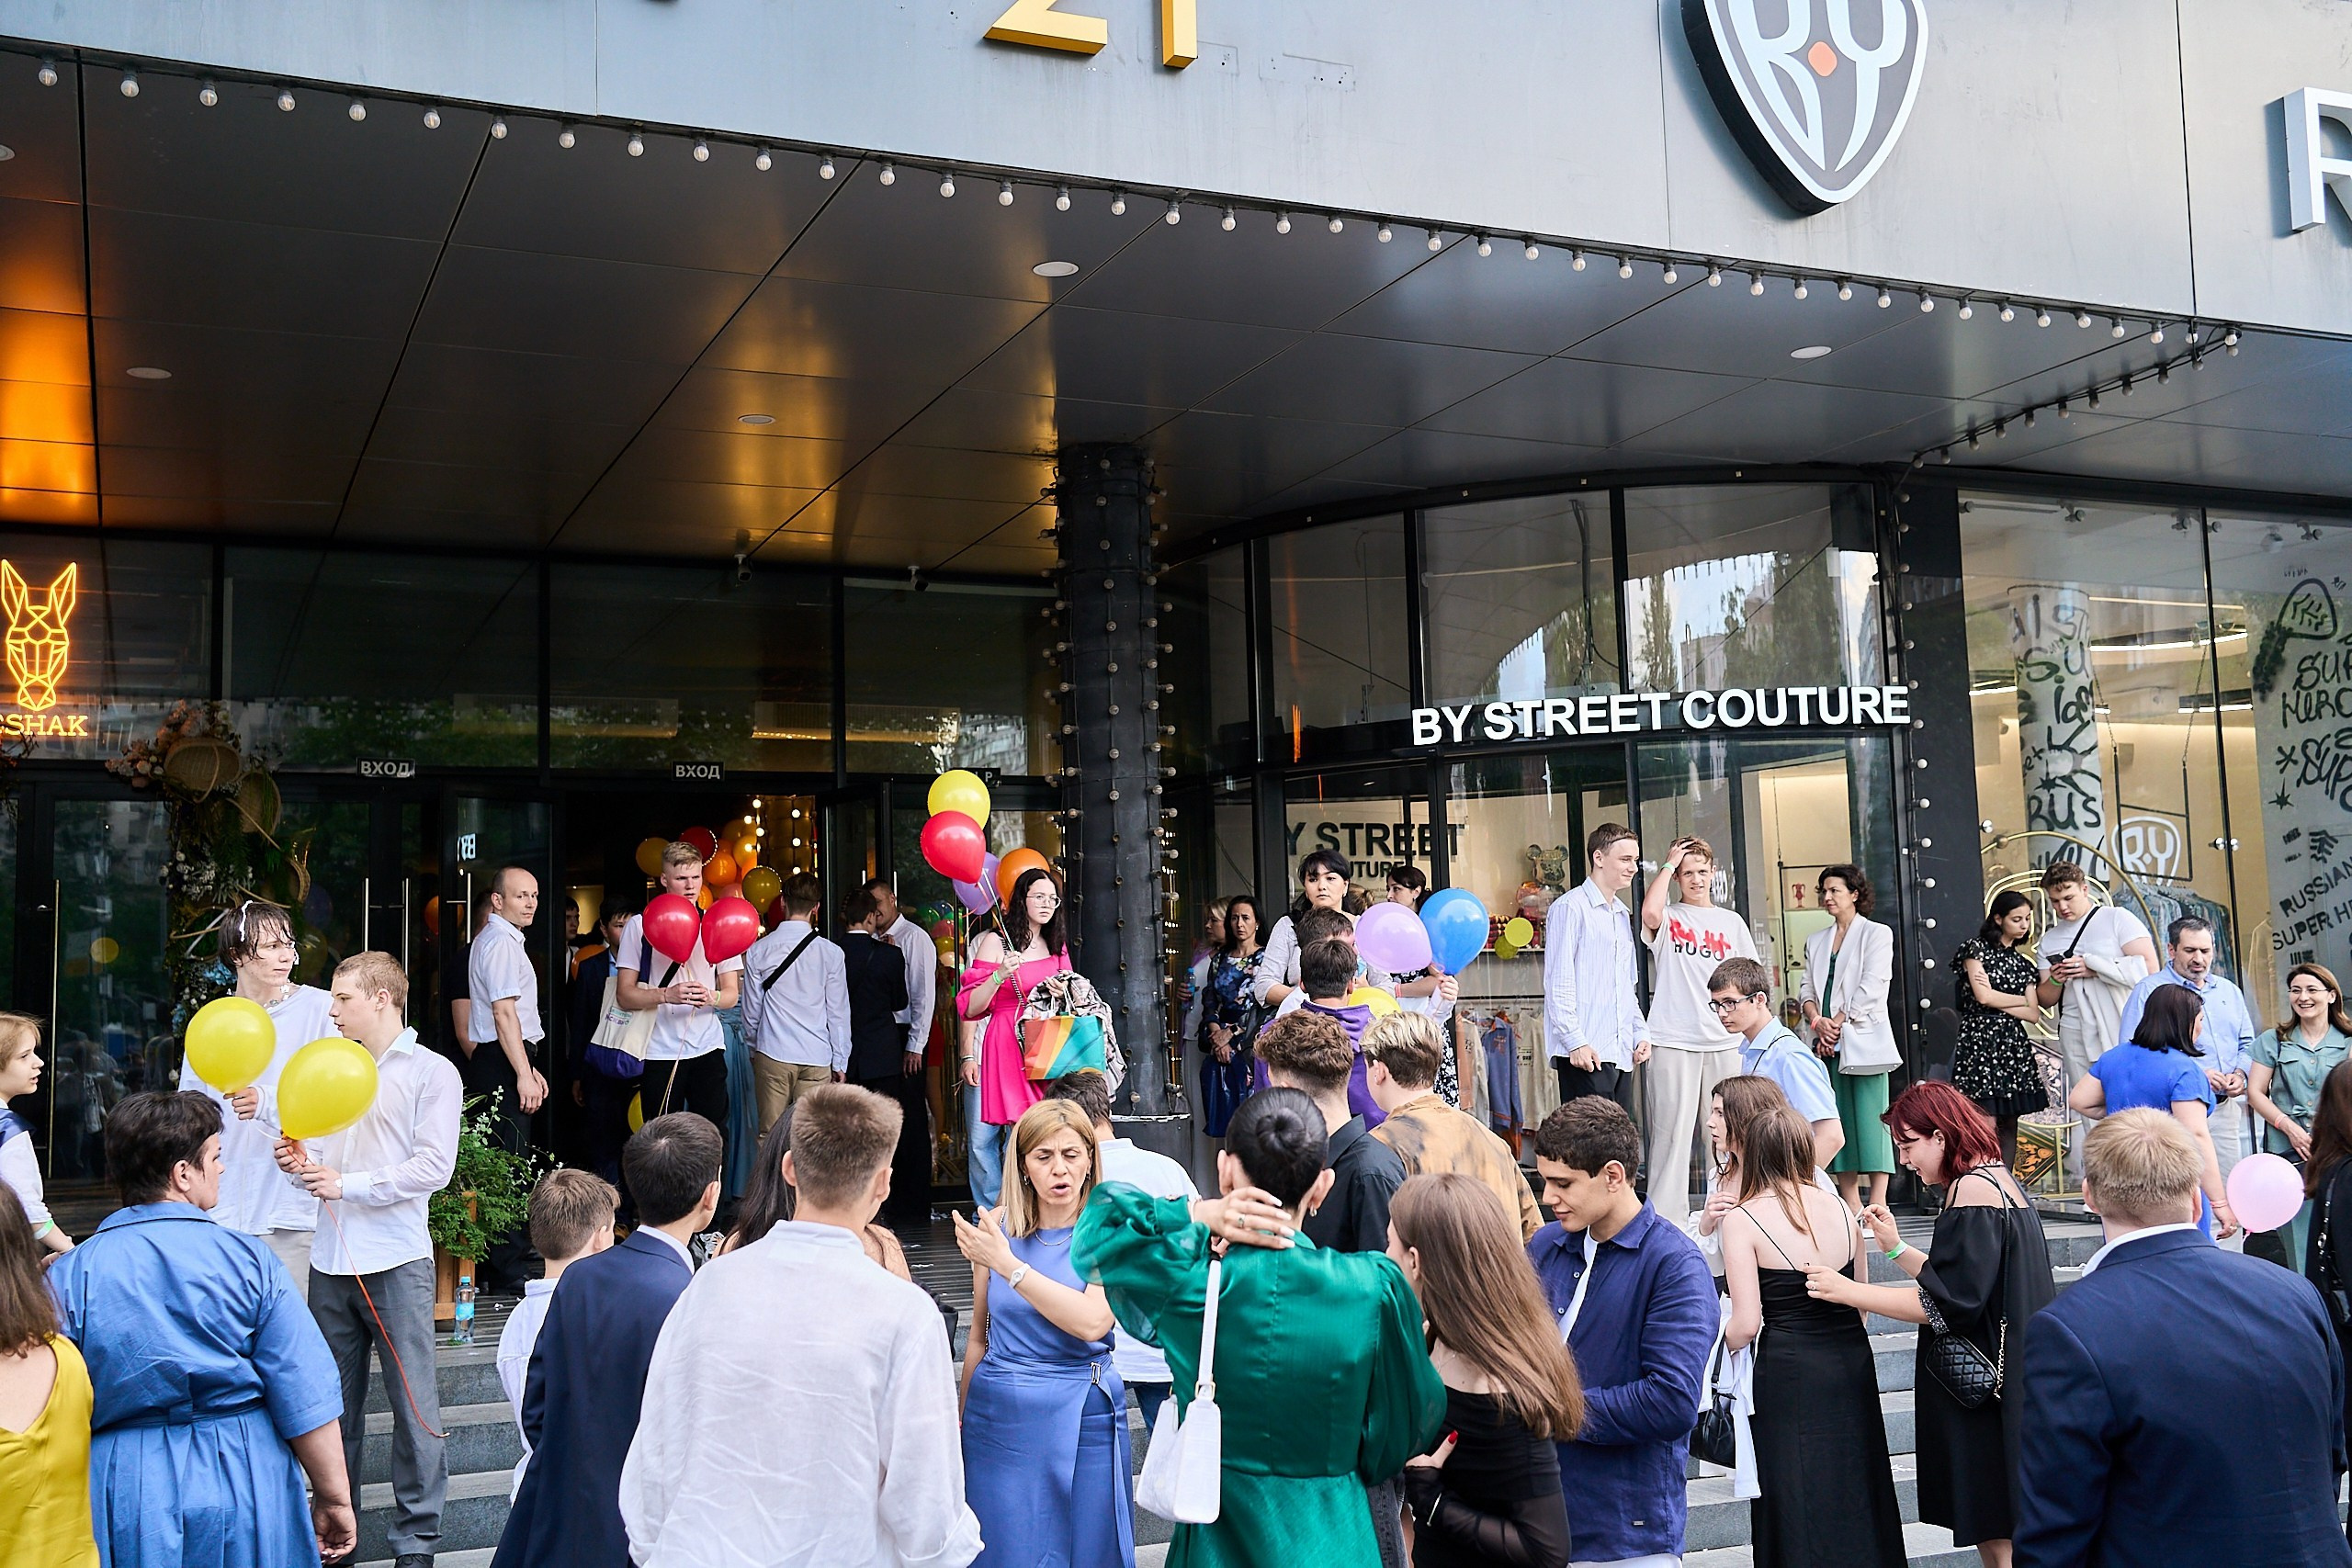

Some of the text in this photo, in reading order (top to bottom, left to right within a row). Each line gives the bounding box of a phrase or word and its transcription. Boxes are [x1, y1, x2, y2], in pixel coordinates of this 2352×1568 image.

[1411, 685, 1912, 746] BY STREET COUTURE
[360, 761, 411, 778] ВХОД
[675, 764, 720, 780] ВХОД
[2278, 856, 2352, 918] RUSSIAN
[2272, 910, 2335, 951] SUPER
[1674, 942, 1725, 962] HUGO
